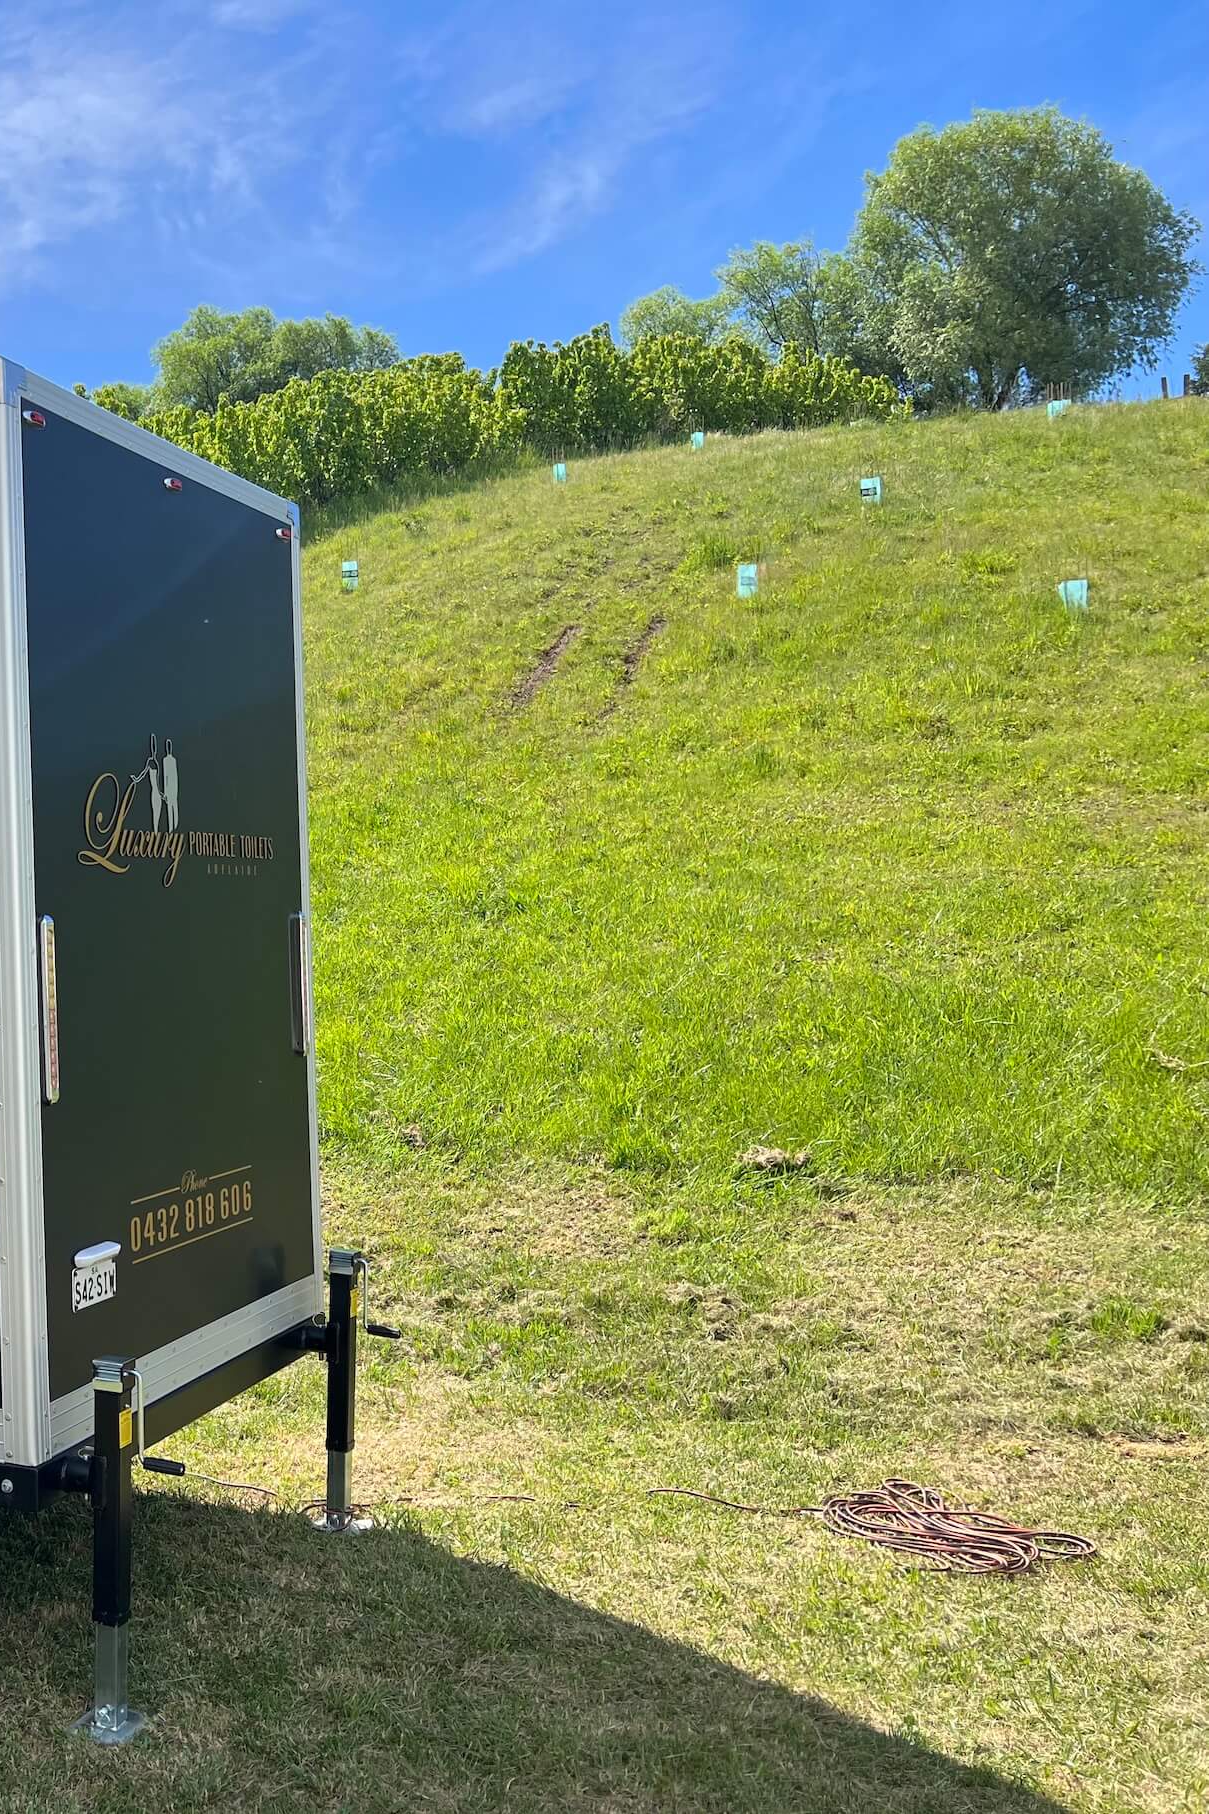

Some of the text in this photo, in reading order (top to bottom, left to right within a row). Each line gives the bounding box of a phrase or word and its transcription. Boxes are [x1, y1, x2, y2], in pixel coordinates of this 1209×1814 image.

[77, 772, 274, 888] Luxury PORTABLE TOILETS
[130, 1180, 252, 1252] 0432 818 606
